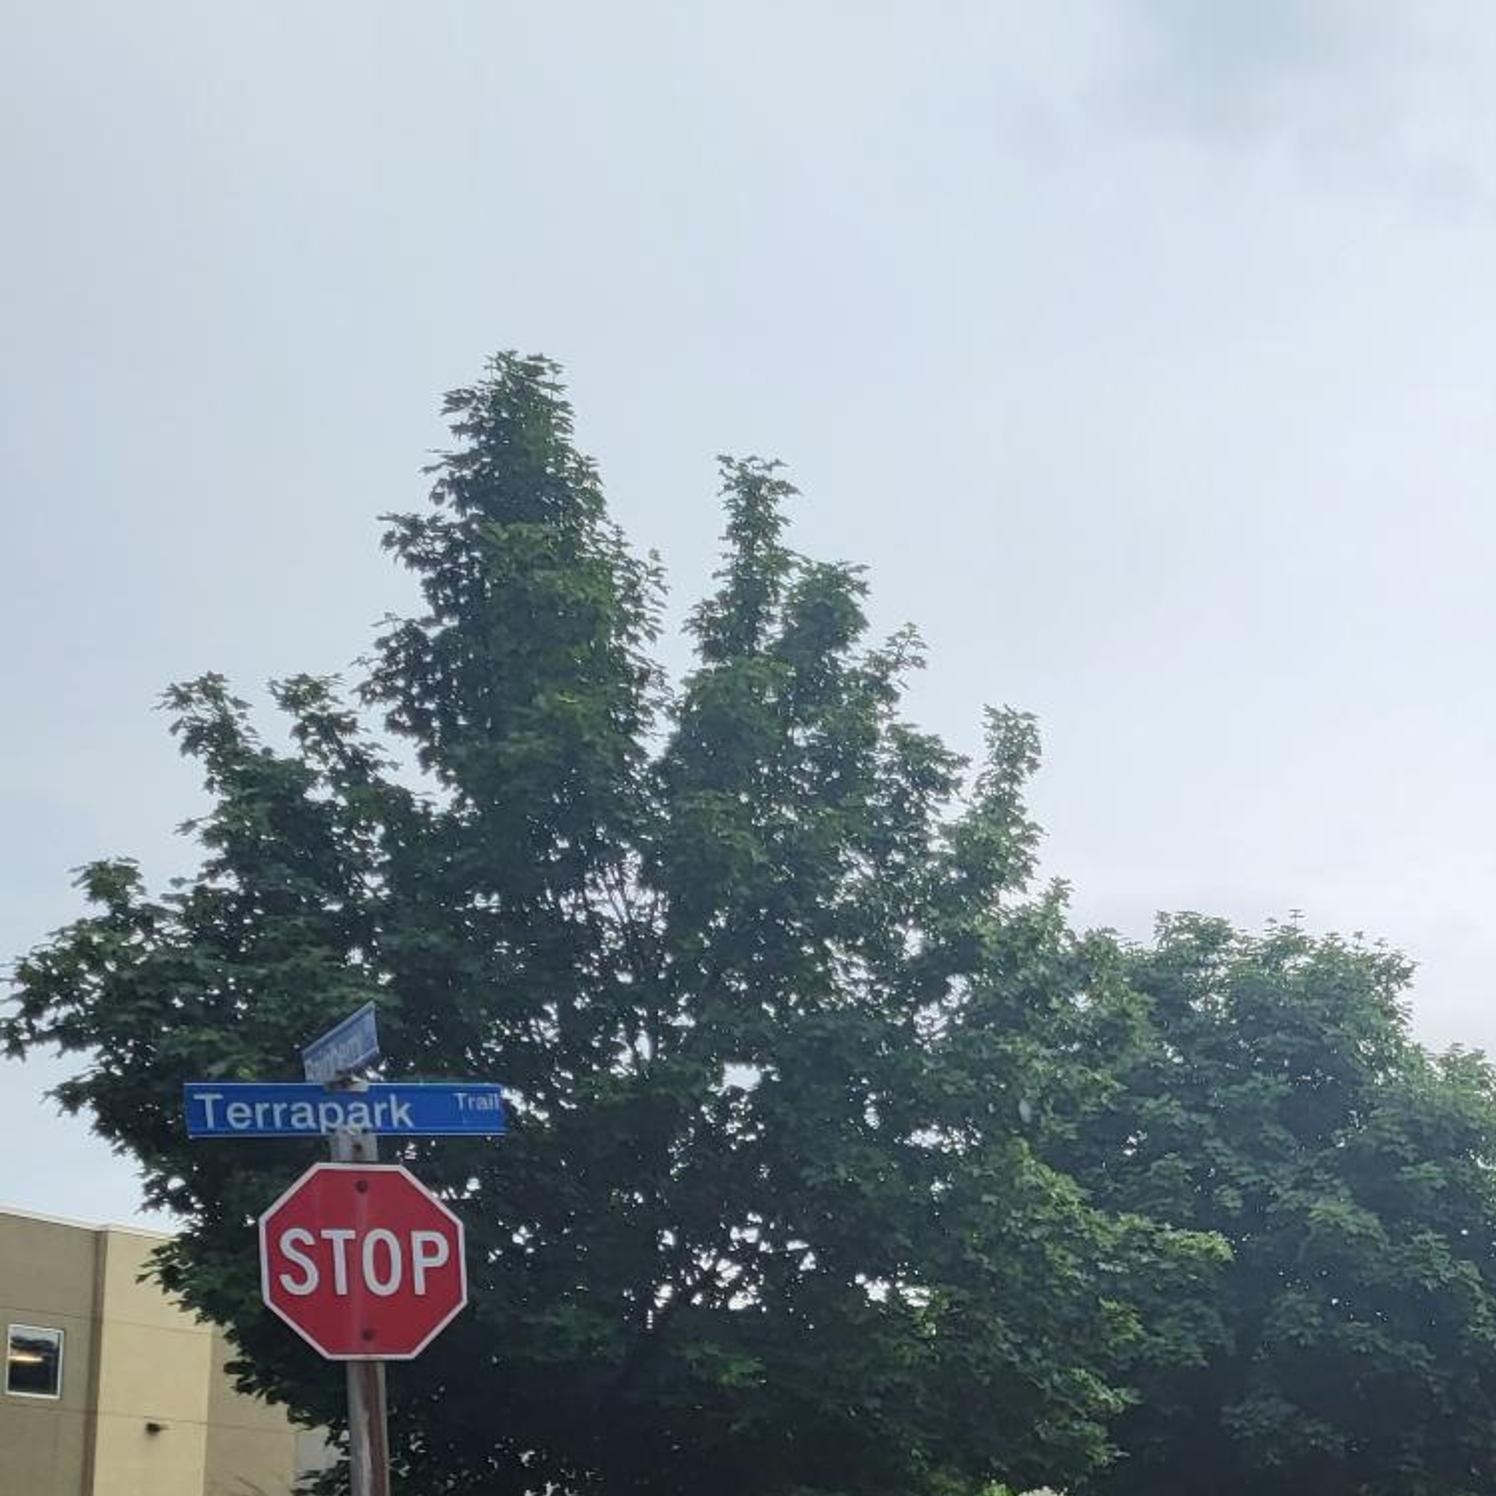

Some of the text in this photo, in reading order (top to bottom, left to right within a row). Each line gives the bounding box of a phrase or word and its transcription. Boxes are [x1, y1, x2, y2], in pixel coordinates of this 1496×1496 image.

[193, 1092, 500, 1134] Terrapark Trail
[278, 1227, 450, 1297] STOP
